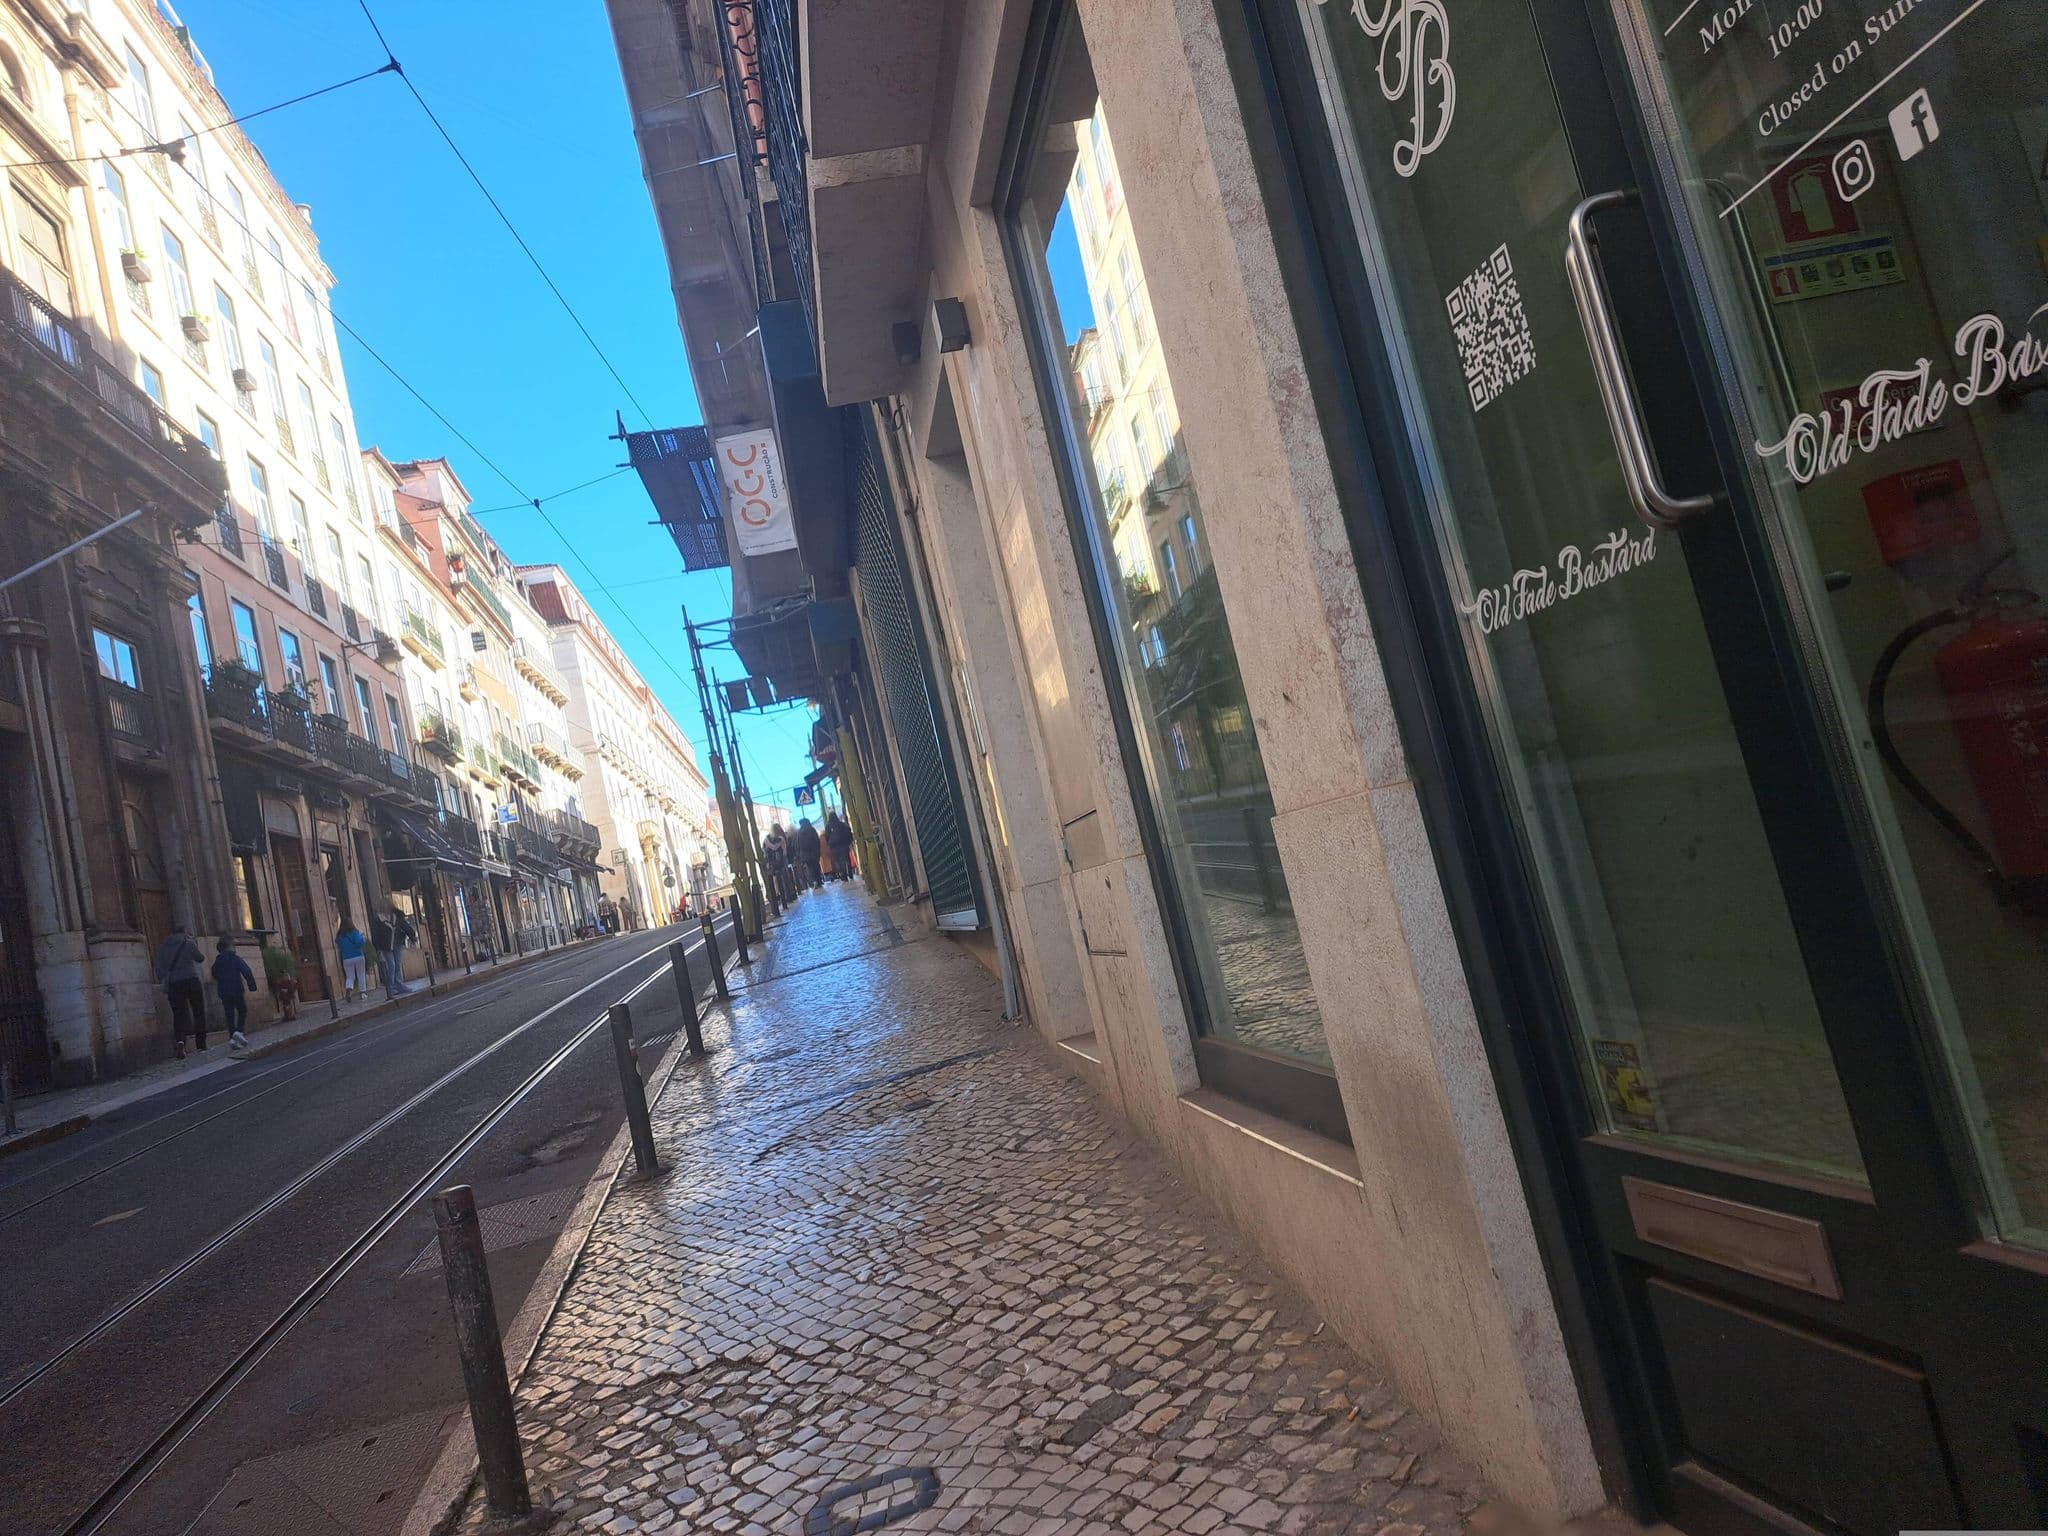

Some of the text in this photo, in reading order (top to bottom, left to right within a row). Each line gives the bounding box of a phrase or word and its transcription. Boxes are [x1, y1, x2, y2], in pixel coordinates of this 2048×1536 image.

[1758, 0, 1922, 136] Closed on Sun
[1768, 0, 1823, 59] 10:00
[1755, 399, 1853, 484] Old
[1857, 357, 1948, 453] Fade
[1461, 584, 1511, 634] Old
[1513, 565, 1557, 620] Fade
